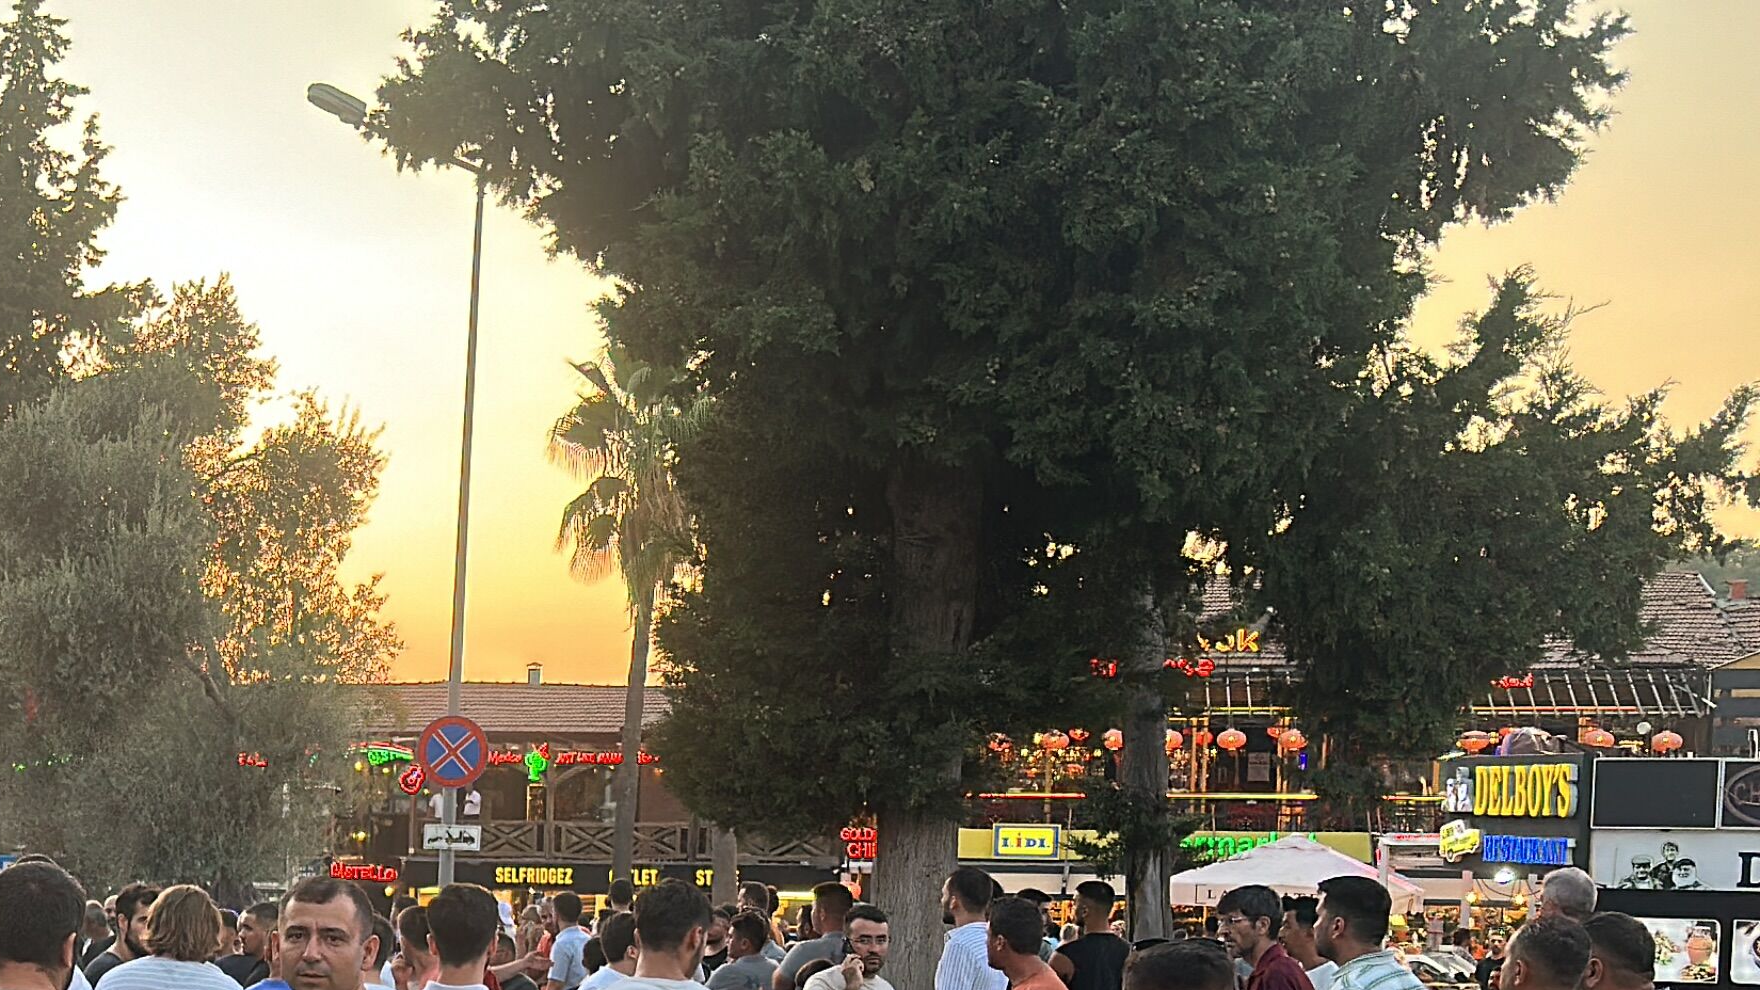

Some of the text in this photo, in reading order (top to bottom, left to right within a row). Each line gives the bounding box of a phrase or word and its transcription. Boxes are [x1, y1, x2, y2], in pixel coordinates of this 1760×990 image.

[1473, 763, 1574, 818] DELBOY'S
[840, 827, 877, 840] GOLD
[1482, 835, 1571, 866] RESTAURANT
[495, 867, 574, 885] SELFRIDGEZ
